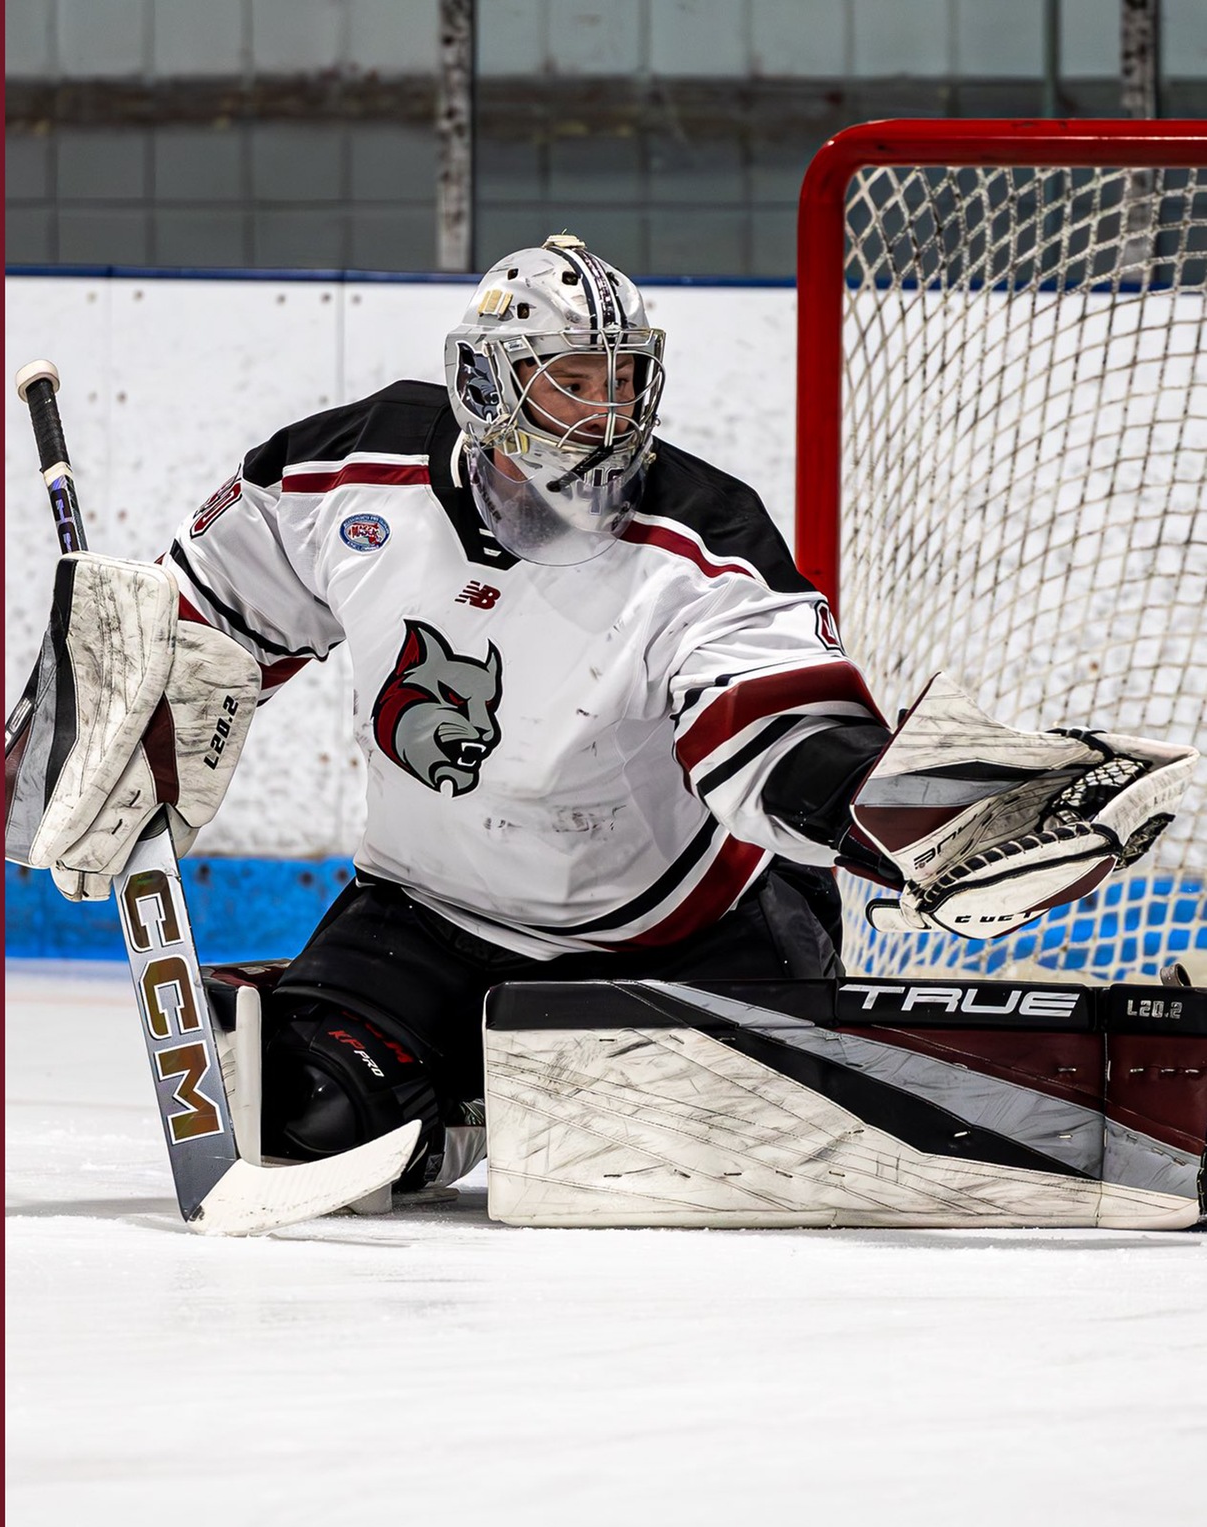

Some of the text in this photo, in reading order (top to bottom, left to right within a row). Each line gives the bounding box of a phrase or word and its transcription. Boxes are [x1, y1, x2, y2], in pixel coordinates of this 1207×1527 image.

[203, 694, 237, 771] L20.2
[119, 868, 225, 1146] CCM
[838, 984, 1081, 1018] TRUE
[1126, 999, 1183, 1019] L20.2
